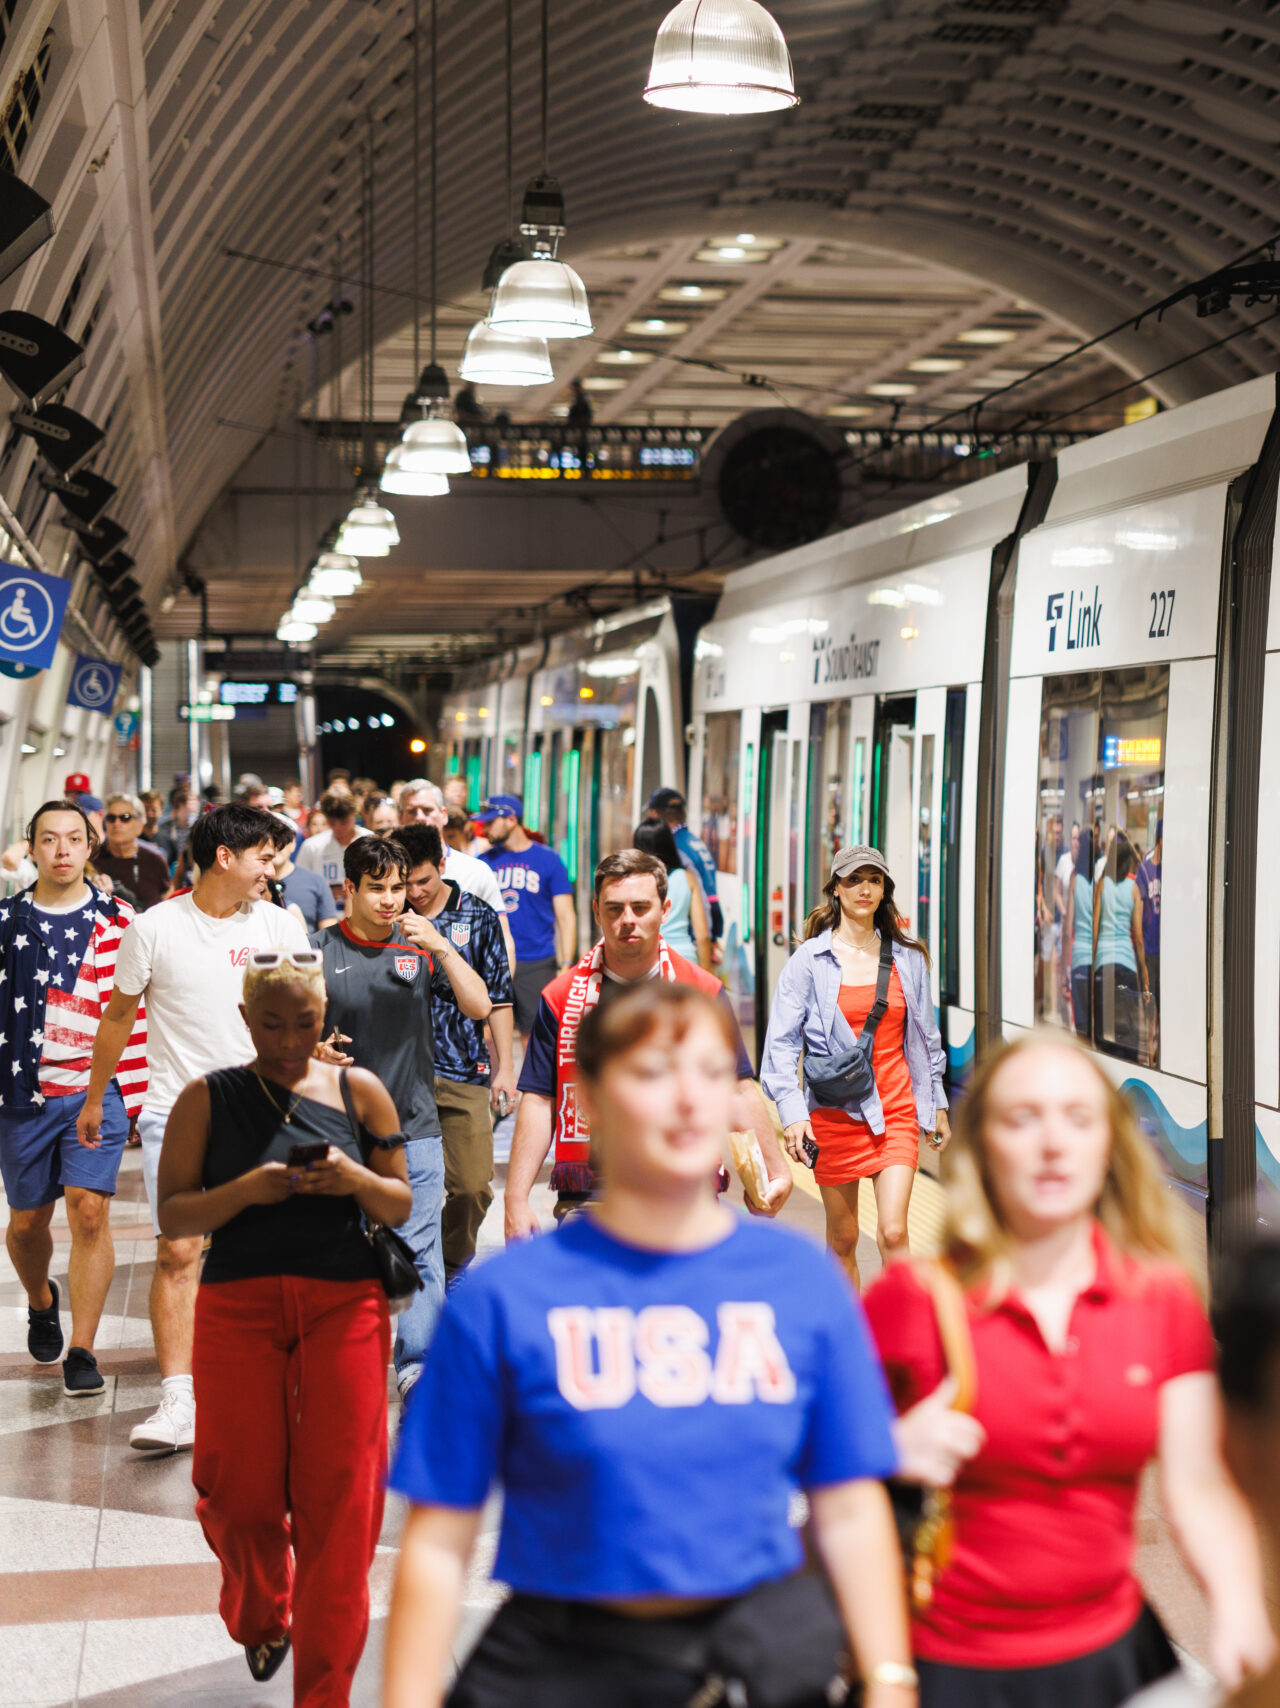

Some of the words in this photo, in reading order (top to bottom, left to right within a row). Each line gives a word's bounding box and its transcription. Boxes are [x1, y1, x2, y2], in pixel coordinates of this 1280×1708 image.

[1066, 585, 1102, 649] Link
[1148, 590, 1176, 638] 227
[494, 866, 540, 893] UBS
[559, 976, 589, 1067] THROUGH
[547, 1301, 796, 1411] USA
